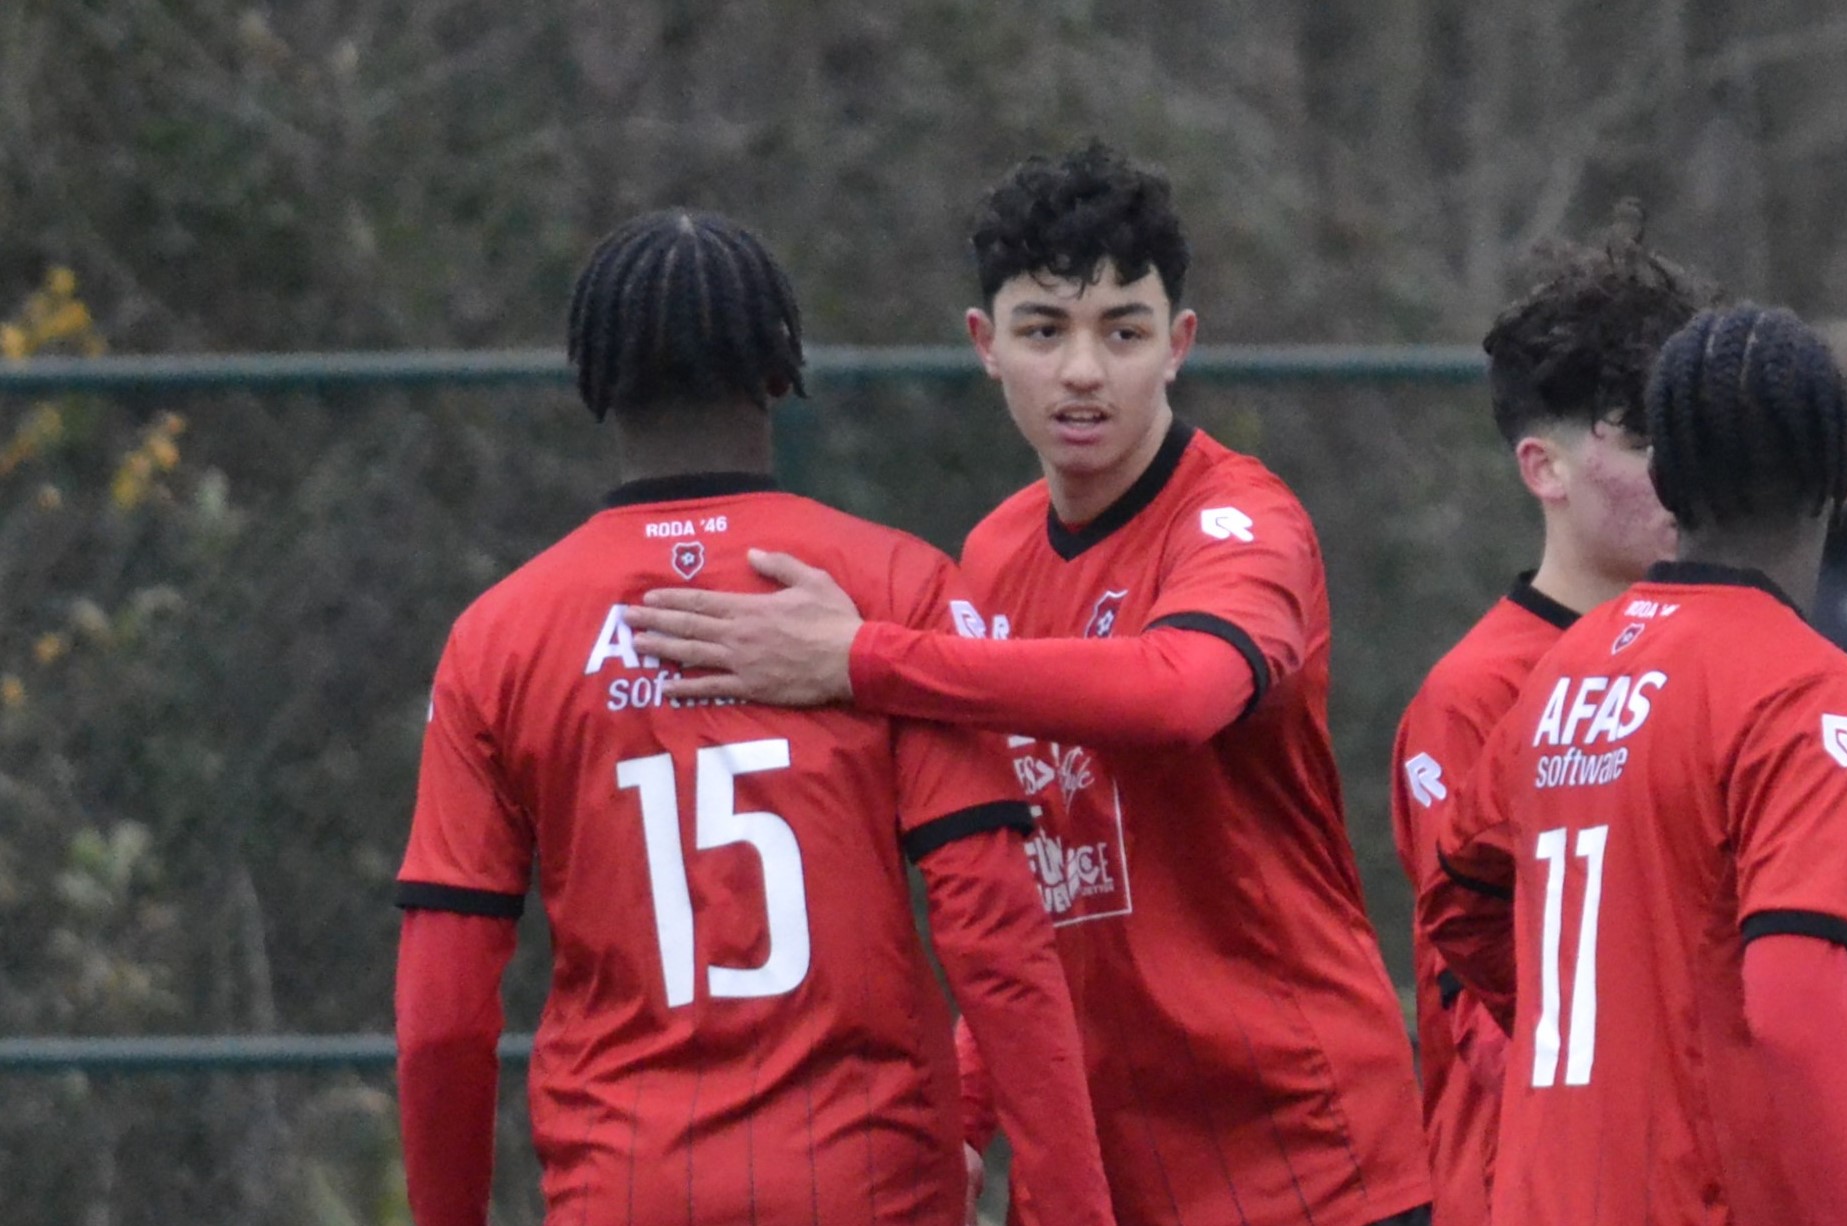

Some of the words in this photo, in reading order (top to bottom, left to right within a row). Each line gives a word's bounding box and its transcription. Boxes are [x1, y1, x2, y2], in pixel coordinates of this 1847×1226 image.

[645, 521, 695, 538] RODA
[700, 516, 728, 532] '46
[1532, 669, 1669, 748] AFAS
[1534, 746, 1629, 789] software
[616, 738, 811, 1009] 15
[1531, 825, 1609, 1088] 11
